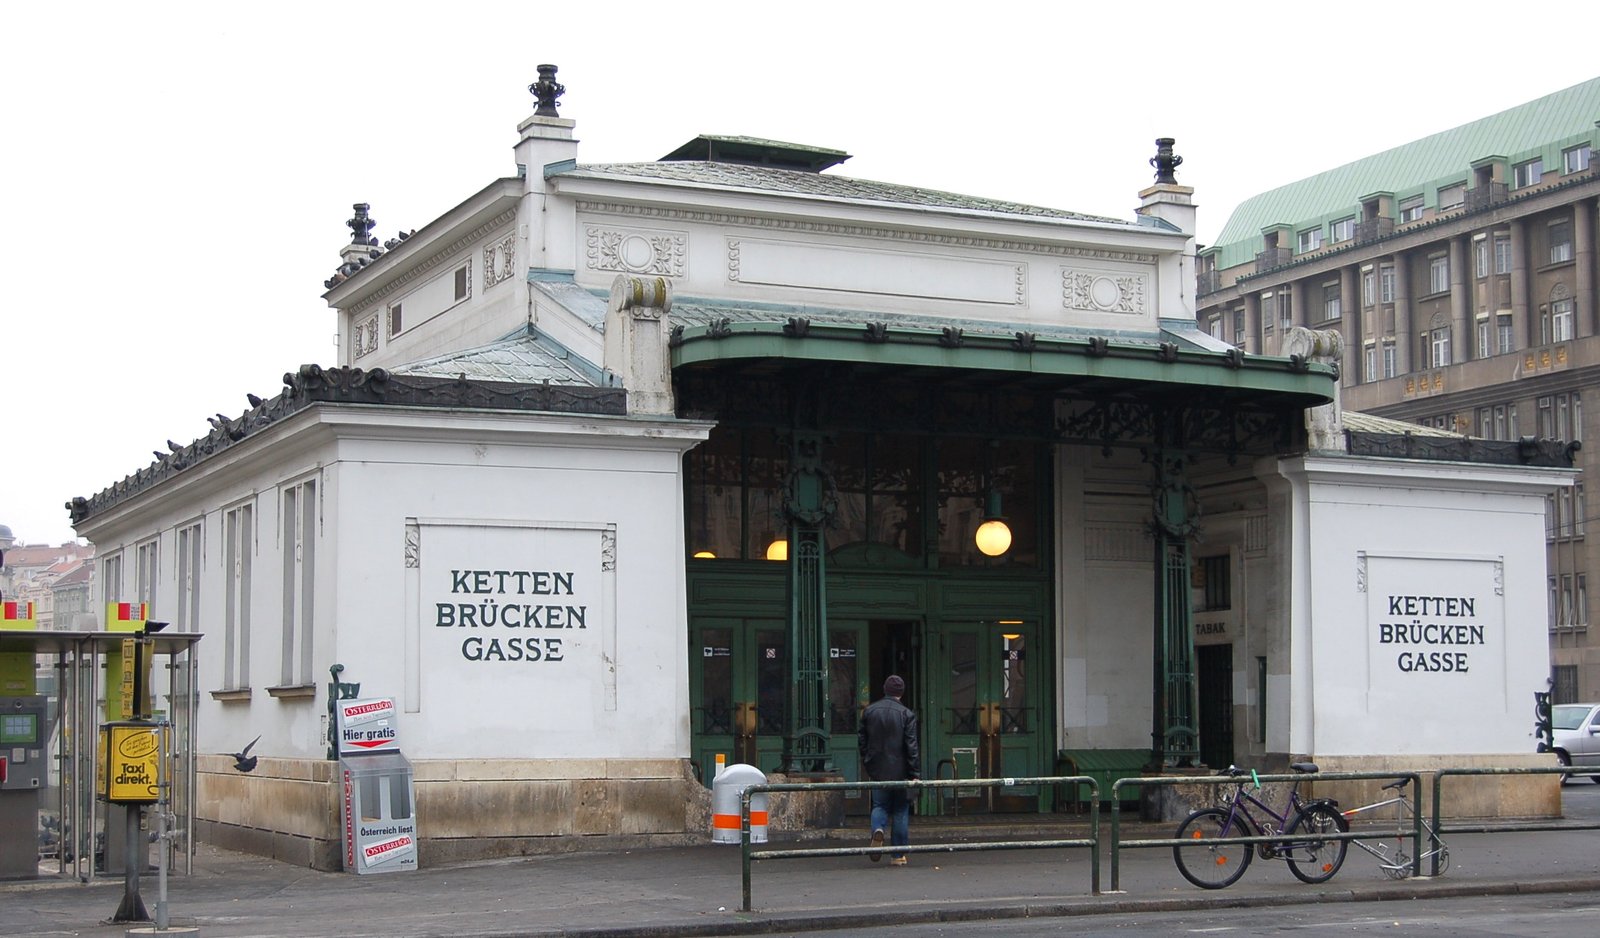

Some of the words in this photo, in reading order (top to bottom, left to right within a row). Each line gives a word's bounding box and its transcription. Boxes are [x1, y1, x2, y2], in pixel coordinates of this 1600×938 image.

[450, 570, 574, 595] KETTEN
[435, 598, 587, 629] BRÜCKEN
[1388, 595, 1475, 617] KETTEN
[1195, 622, 1226, 635] TABAK
[1379, 619, 1485, 645] BRÜCKEN
[461, 637, 564, 662] GASSE
[1397, 652, 1469, 673] GASSE
[343, 730, 364, 741] Hier
[366, 727, 396, 741] gratis
[121, 762, 145, 774] Taxi
[115, 773, 152, 785] direkt.
[360, 826, 397, 837] Österreich
[398, 825, 413, 834] liest
